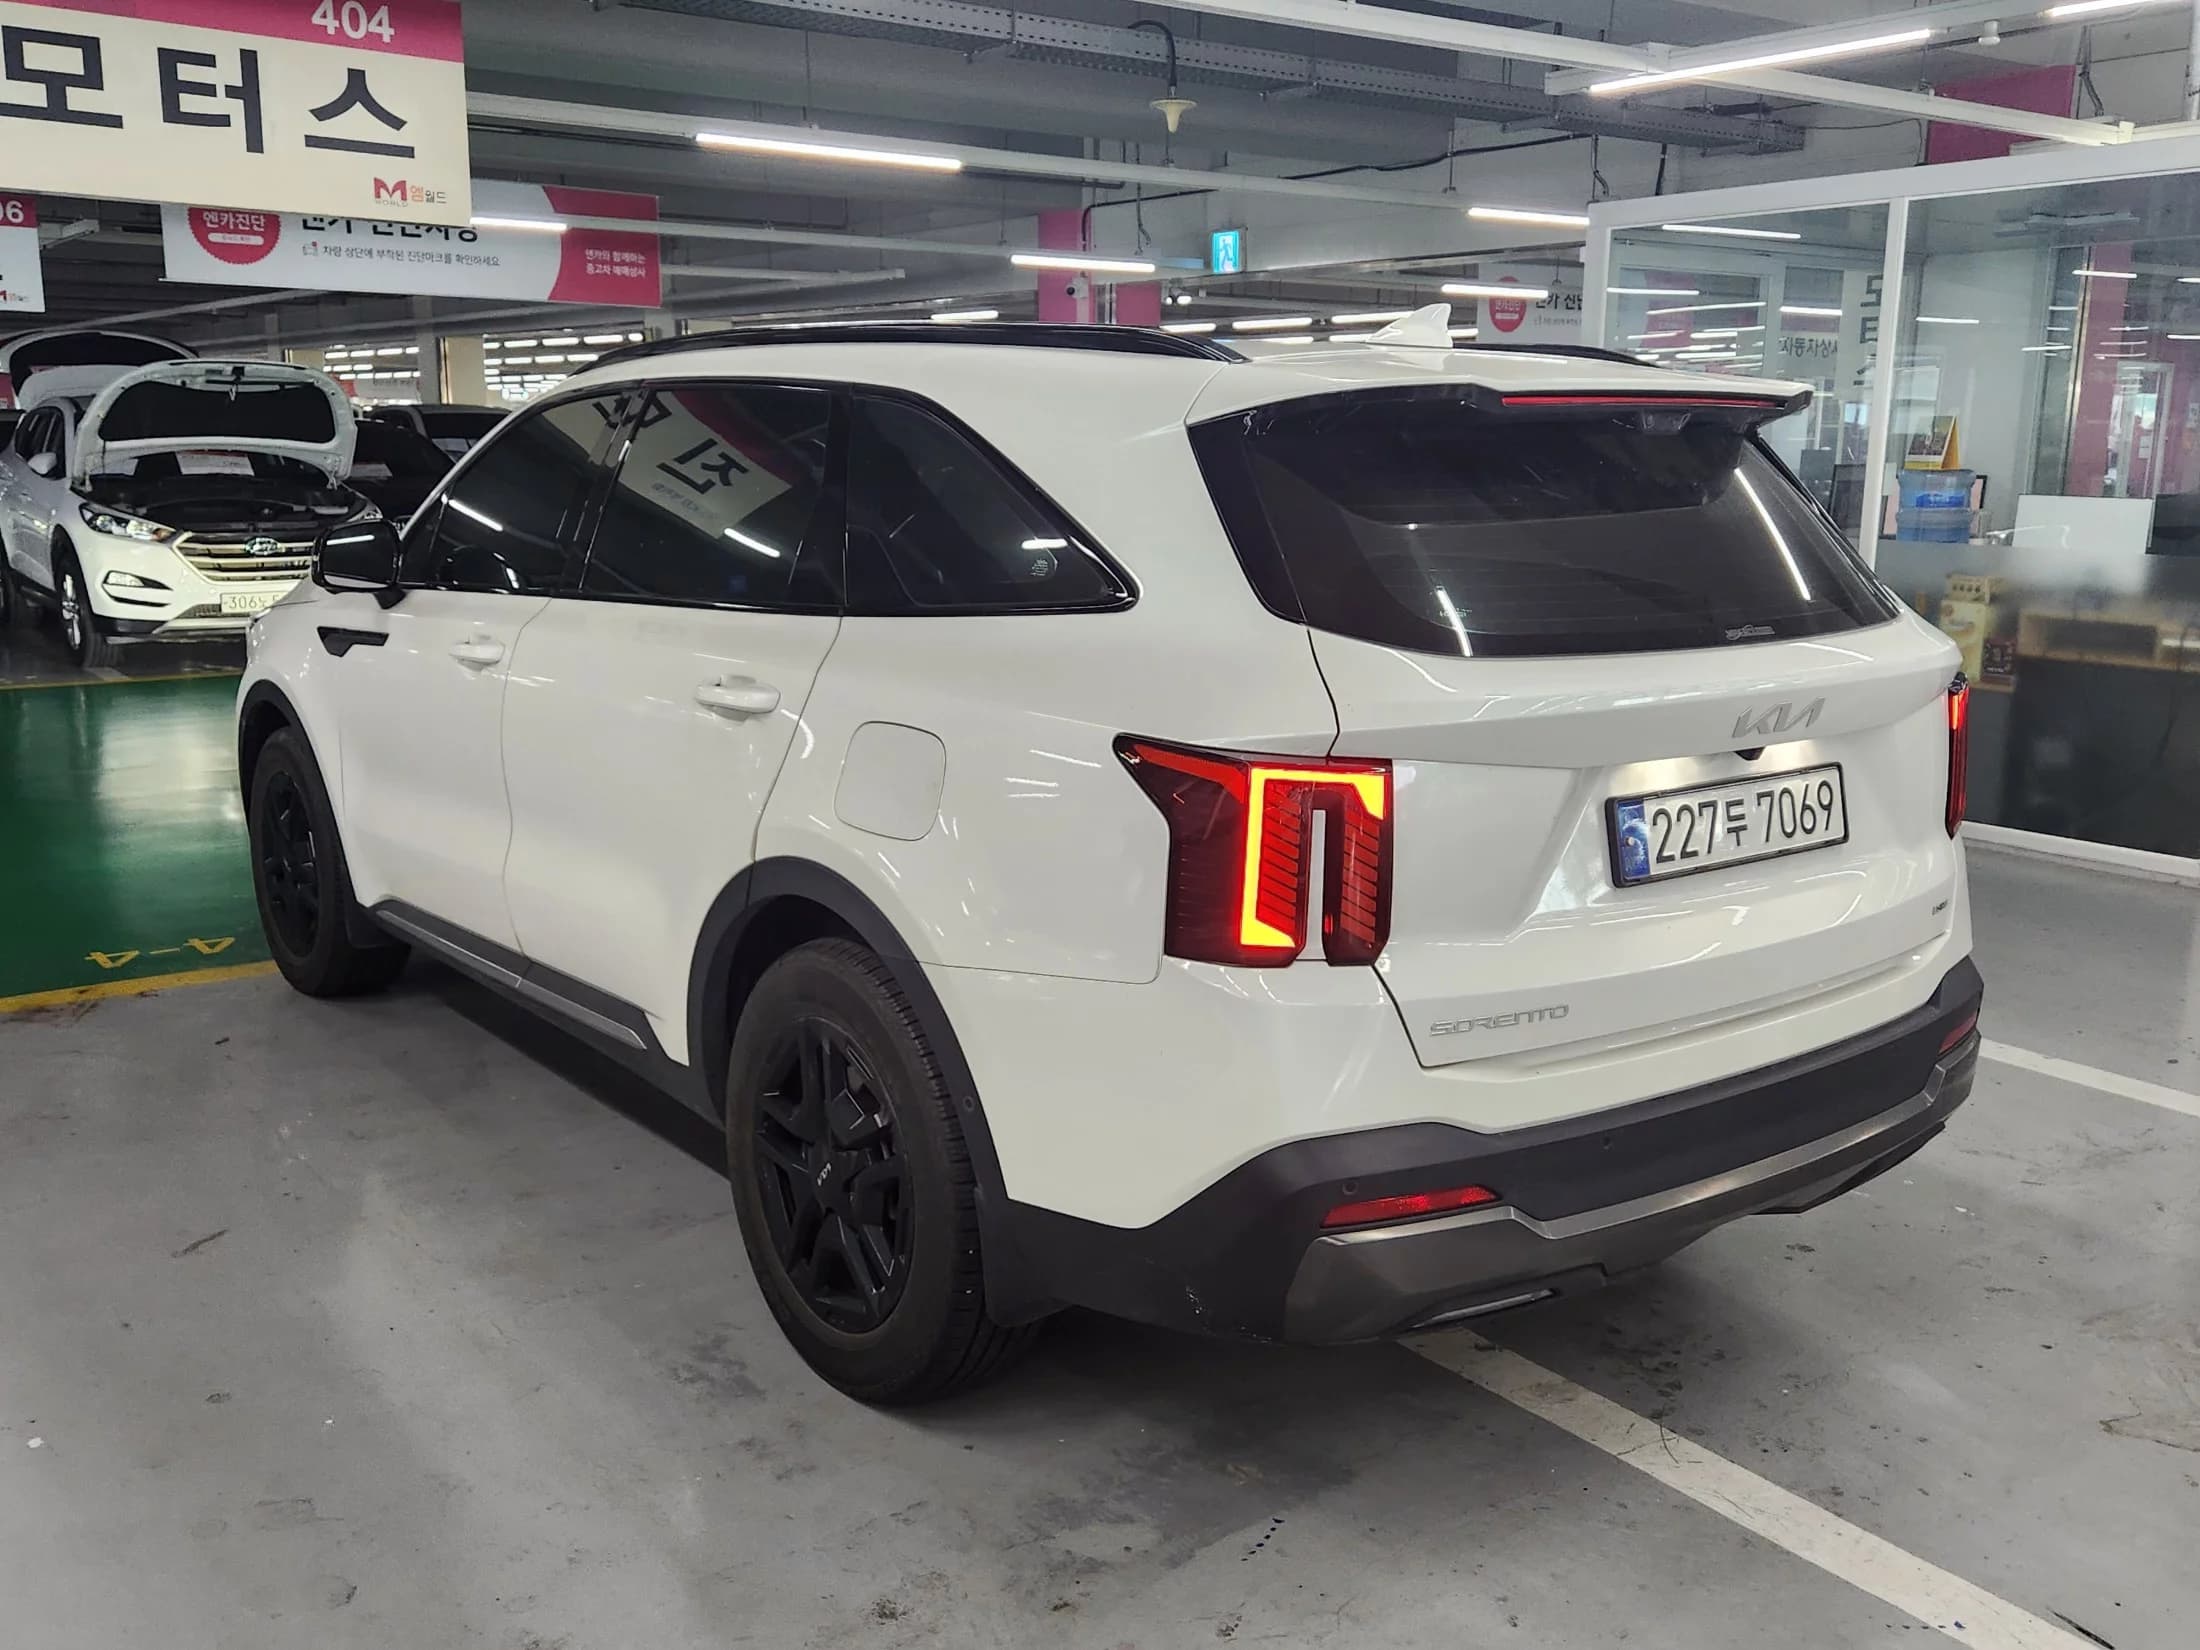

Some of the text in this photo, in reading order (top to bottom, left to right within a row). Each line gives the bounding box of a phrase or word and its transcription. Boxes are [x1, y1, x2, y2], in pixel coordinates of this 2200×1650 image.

[311, 0, 396, 43] 404
[0, 25, 415, 159] 모터스
[410, 185, 447, 204] 엠월드
[0, 200, 25, 223] 6
[202, 210, 266, 232] 엔카진단
[322, 245, 342, 258] 차량
[455, 253, 500, 266] 확인하세요
[1732, 697, 1826, 739] KIA
[1652, 780, 1834, 864] 227두 7069
[1430, 1004, 1569, 1037] SORENTO
